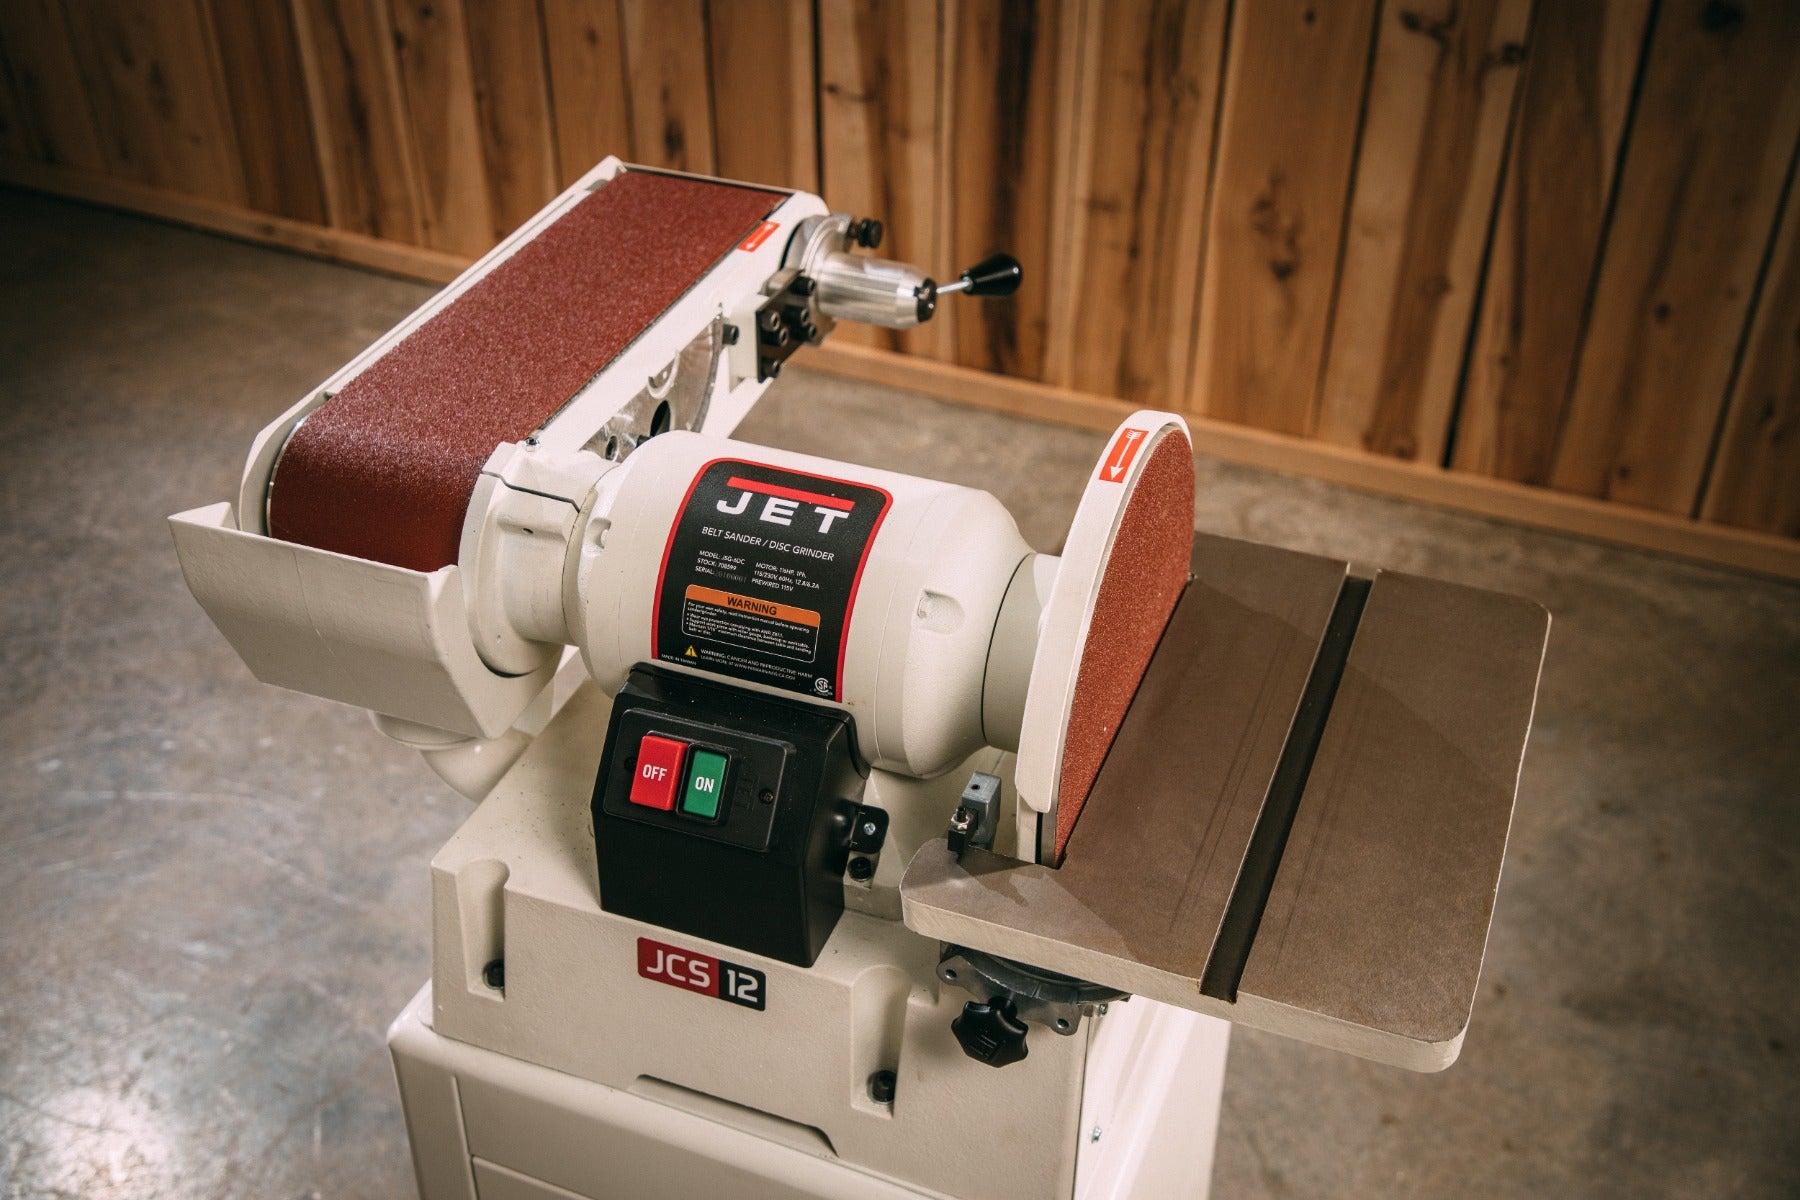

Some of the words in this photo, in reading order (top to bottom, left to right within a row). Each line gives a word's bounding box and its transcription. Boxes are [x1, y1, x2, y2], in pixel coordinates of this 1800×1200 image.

[716, 491, 850, 534] JET
[702, 526, 723, 537] BELT
[724, 531, 761, 546] SANDER
[762, 539, 769, 547] /
[769, 540, 791, 552] DISC
[793, 546, 835, 561] GRINDER
[697, 558, 718, 566] STOCK:
[699, 550, 721, 559] MODEL:
[756, 562, 778, 572] MOTOR:
[751, 578, 780, 589] PREWIRED
[728, 597, 777, 615] WARNING
[642, 764, 668, 781] OFF
[695, 776, 715, 793] ON
[647, 949, 710, 988] JCS
[727, 969, 759, 1003] 12
